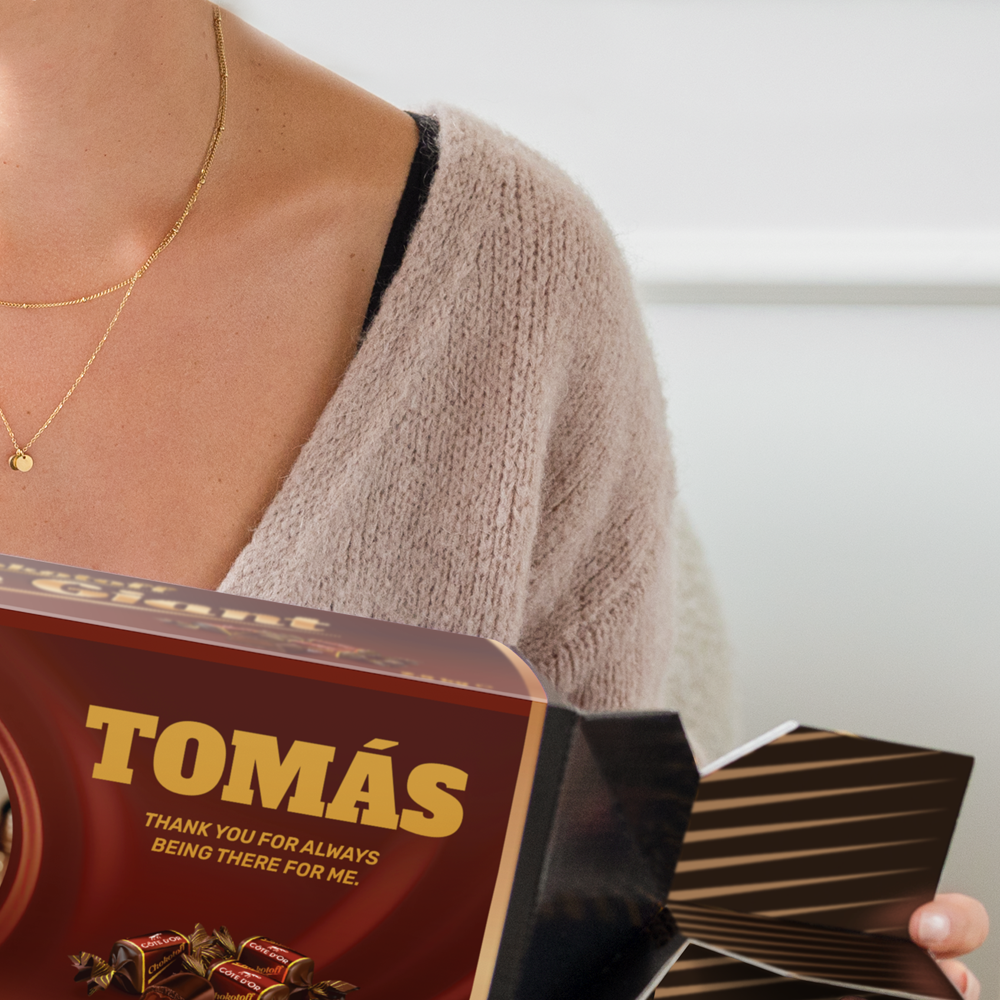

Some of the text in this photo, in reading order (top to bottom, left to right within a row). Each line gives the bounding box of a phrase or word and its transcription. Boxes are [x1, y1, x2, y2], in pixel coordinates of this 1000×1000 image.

[31, 577, 331, 632] Giant
[85, 704, 469, 838] TOMÁS
[145, 811, 381, 866] THANK YOU FOR ALWAYS
[151, 836, 360, 887] BEING THERE FOR ME.
